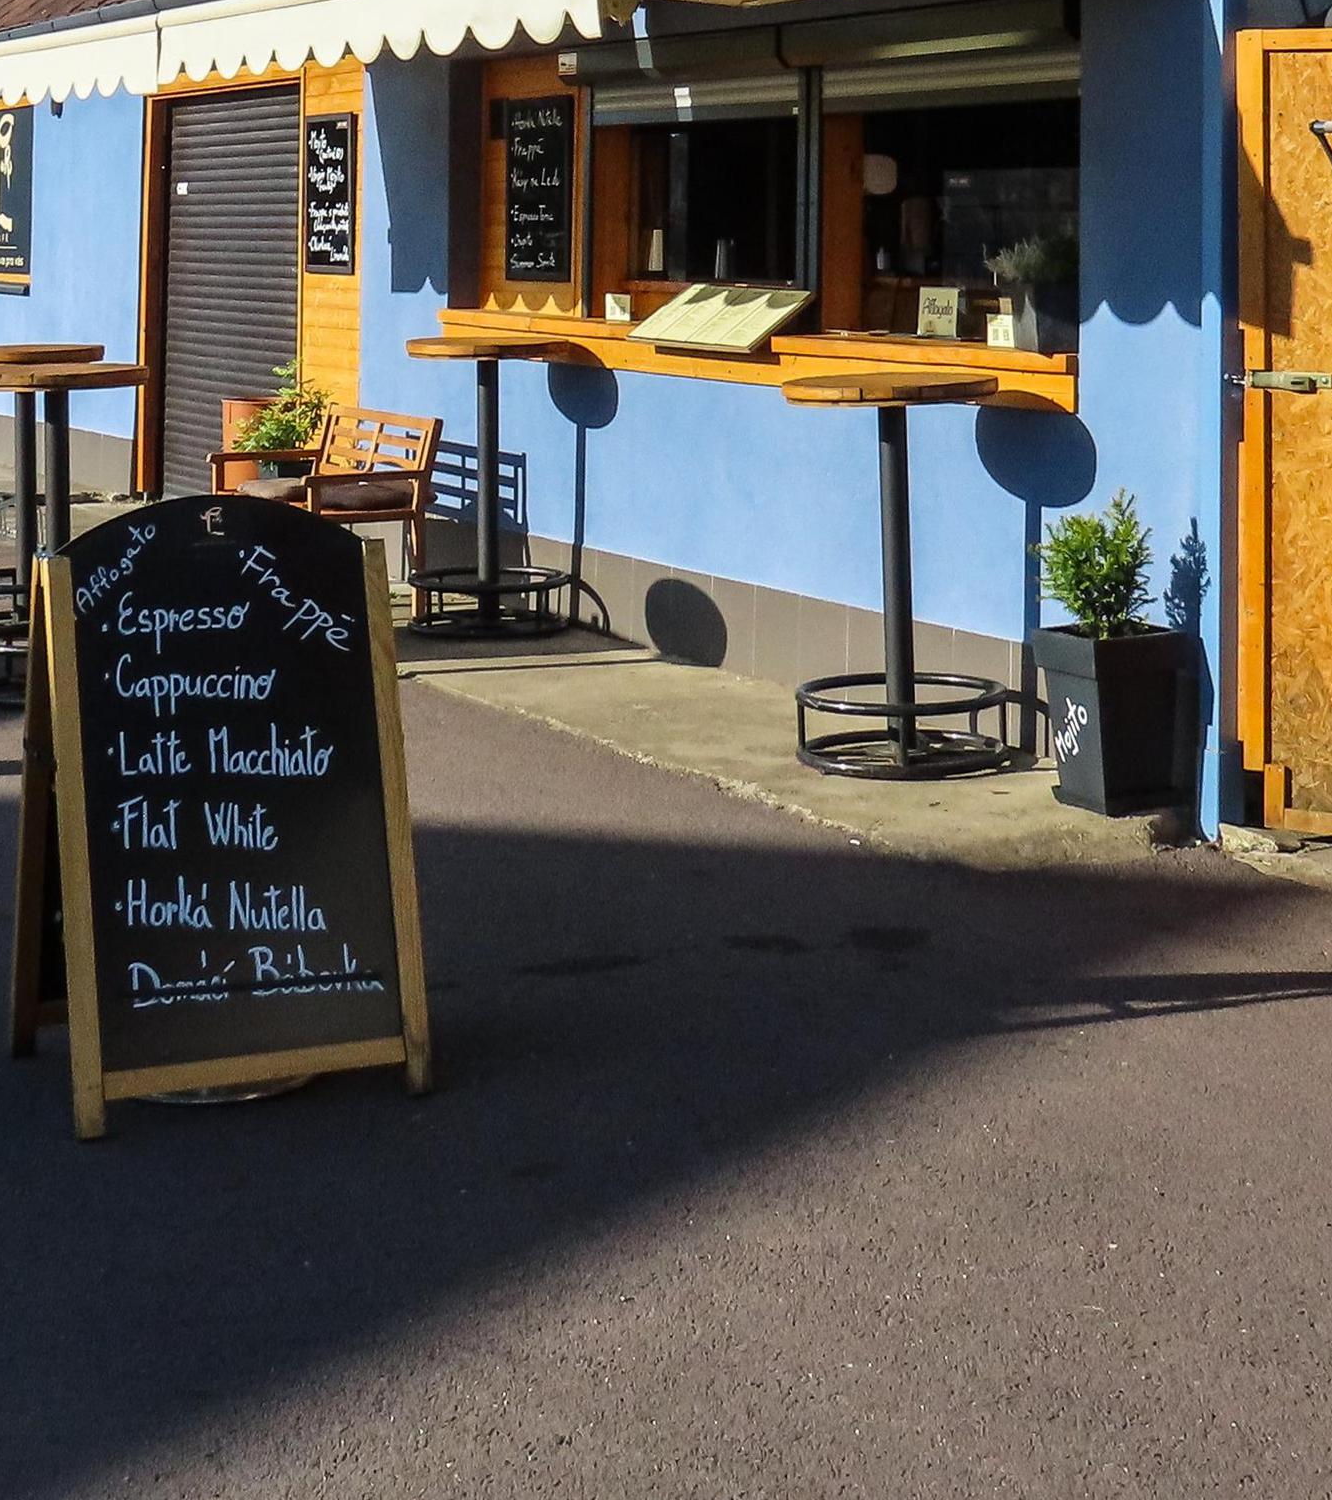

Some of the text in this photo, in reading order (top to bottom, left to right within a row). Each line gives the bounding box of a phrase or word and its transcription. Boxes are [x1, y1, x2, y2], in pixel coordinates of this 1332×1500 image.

[76, 524, 156, 613] Affogato
[119, 592, 250, 654] Espresso
[116, 650, 275, 716] Cappuccino
[120, 722, 334, 777] Latte Macchiato
[1054, 696, 1088, 763] Mojito
[121, 796, 279, 851] Flat White
[128, 876, 327, 932] Horká Nutella
